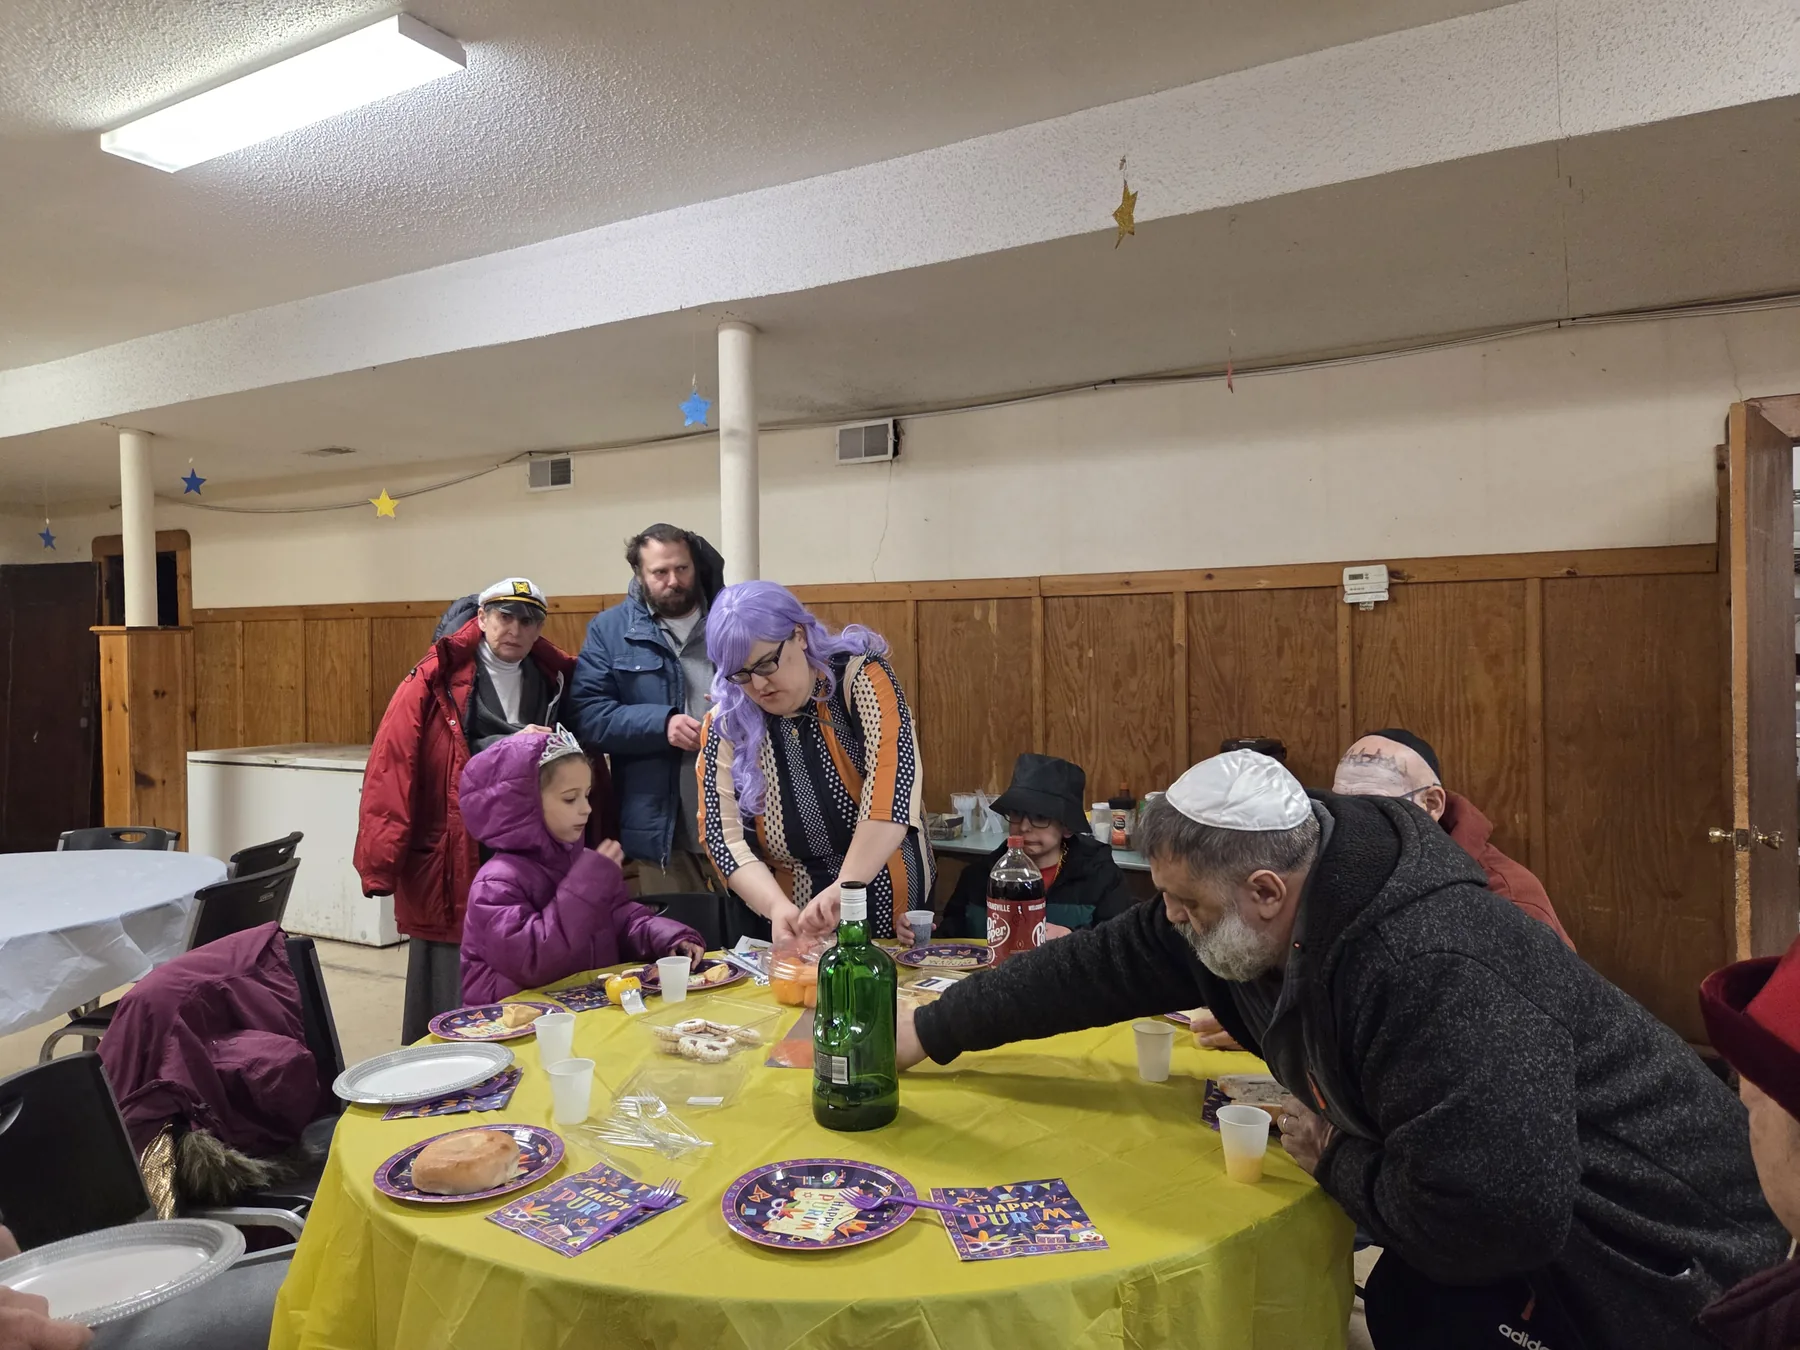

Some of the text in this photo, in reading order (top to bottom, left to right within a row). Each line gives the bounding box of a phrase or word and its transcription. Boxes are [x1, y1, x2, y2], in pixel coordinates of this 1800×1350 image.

[987, 917, 997, 929] Dr
[987, 925, 1006, 944] pper
[552, 1188, 621, 1222] PURIM
[580, 1186, 633, 1211] HAPPY
[977, 1200, 1047, 1214] HAPPY
[795, 1193, 836, 1230] PURIM
[819, 1201, 846, 1227] HAPPY
[966, 1207, 1072, 1229] PURIM
